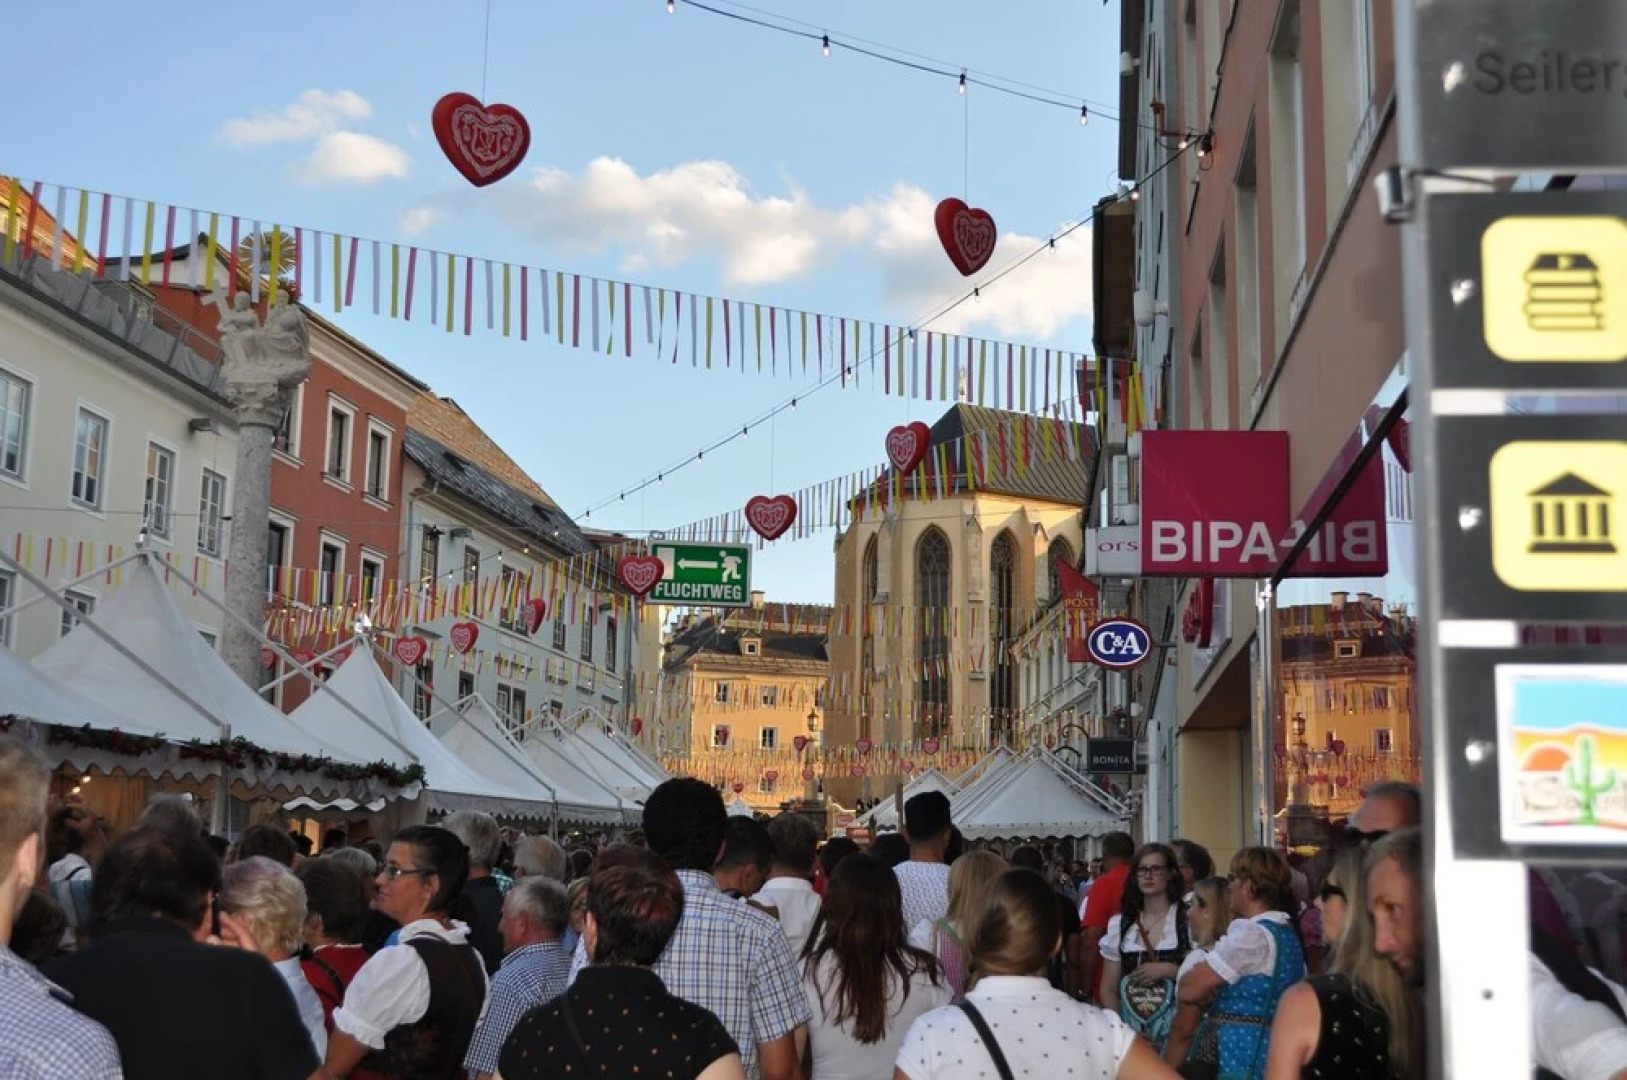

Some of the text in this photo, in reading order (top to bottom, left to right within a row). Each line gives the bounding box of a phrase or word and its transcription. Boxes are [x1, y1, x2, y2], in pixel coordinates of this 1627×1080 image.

[1475, 51, 1627, 98] Seiler
[1151, 521, 1278, 564] BIPA
[655, 582, 742, 600] FLUCHTWEG
[1097, 631, 1143, 655] C&A
[1093, 754, 1130, 765] BONITA
